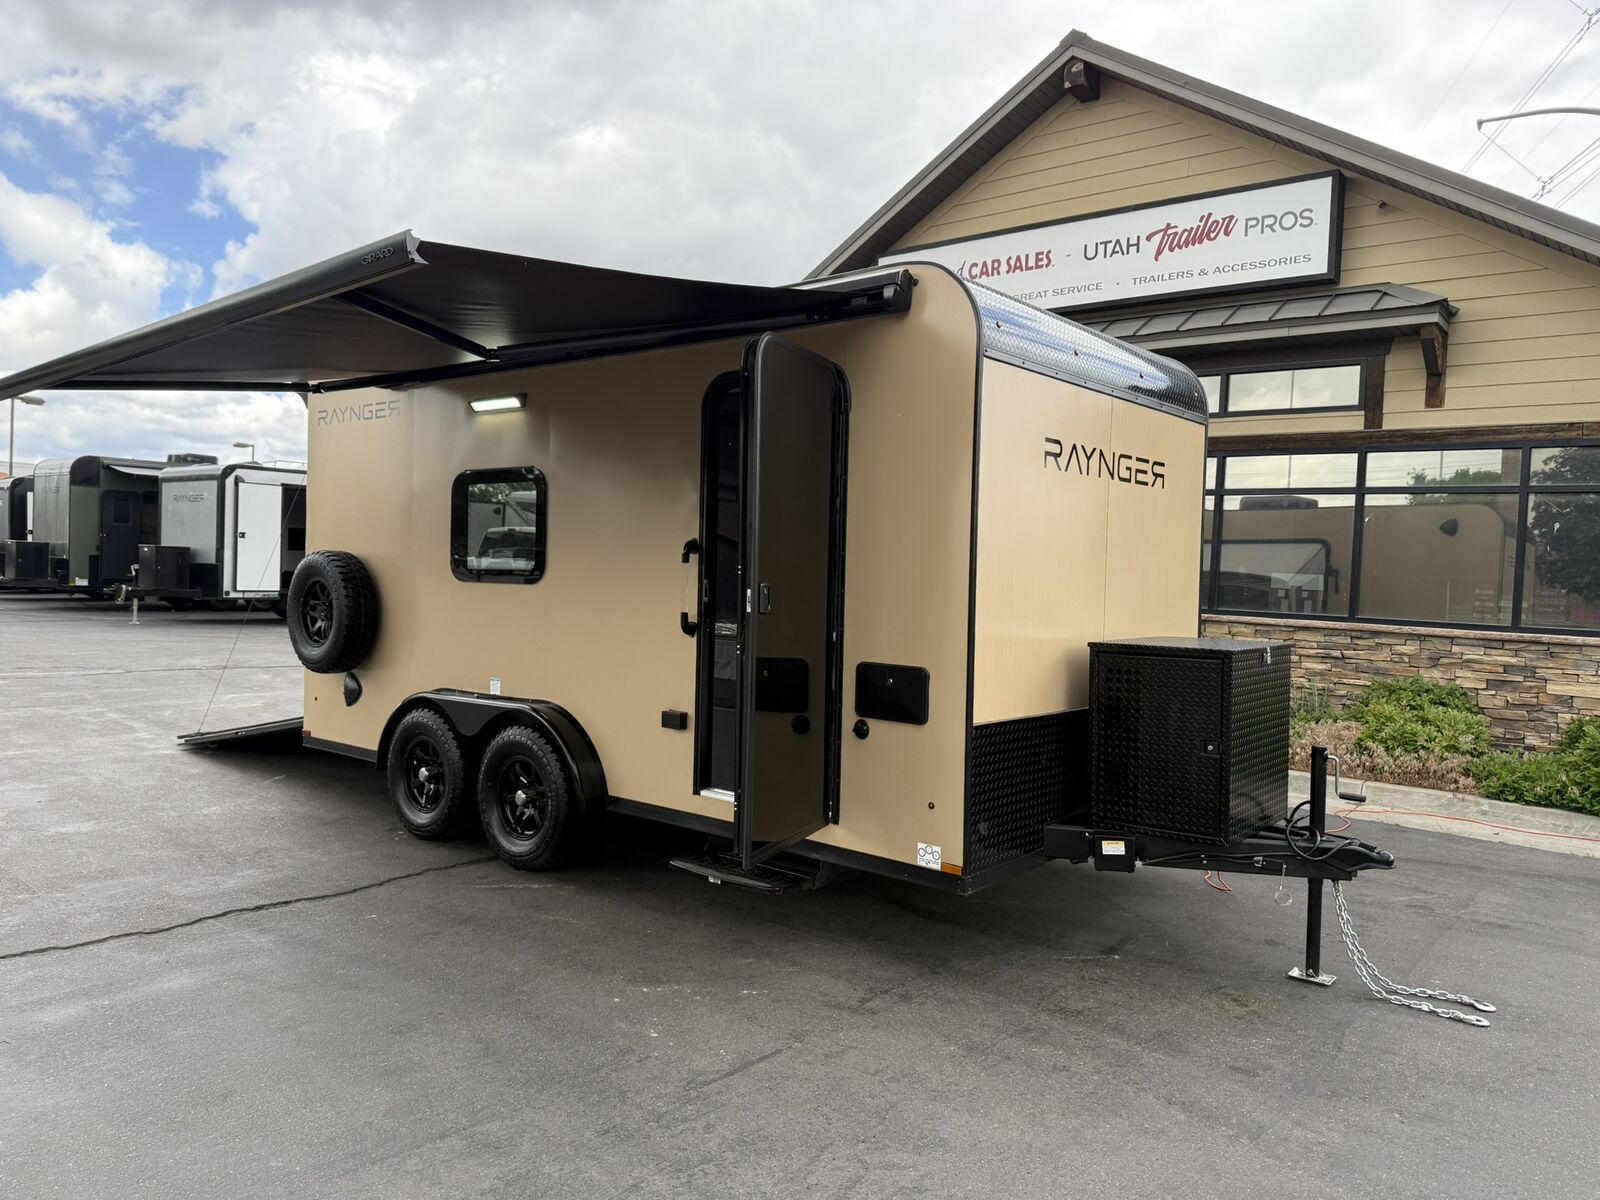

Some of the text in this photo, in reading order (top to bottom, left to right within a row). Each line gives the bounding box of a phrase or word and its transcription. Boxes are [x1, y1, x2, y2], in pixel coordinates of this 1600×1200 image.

[361, 247, 394, 264] GIRARD
[968, 258, 1001, 280] CAR
[1005, 249, 1052, 275] SALES
[1083, 235, 1141, 261] UTAH
[1244, 208, 1314, 237] PROS
[1051, 282, 1103, 297] SERVICE
[1131, 269, 1194, 286] TRAILERS
[1197, 267, 1209, 277] &
[1212, 254, 1312, 275] ACCESSORIES
[318, 400, 400, 426] RAYNGER
[1044, 436, 1166, 489] RAYNGER
